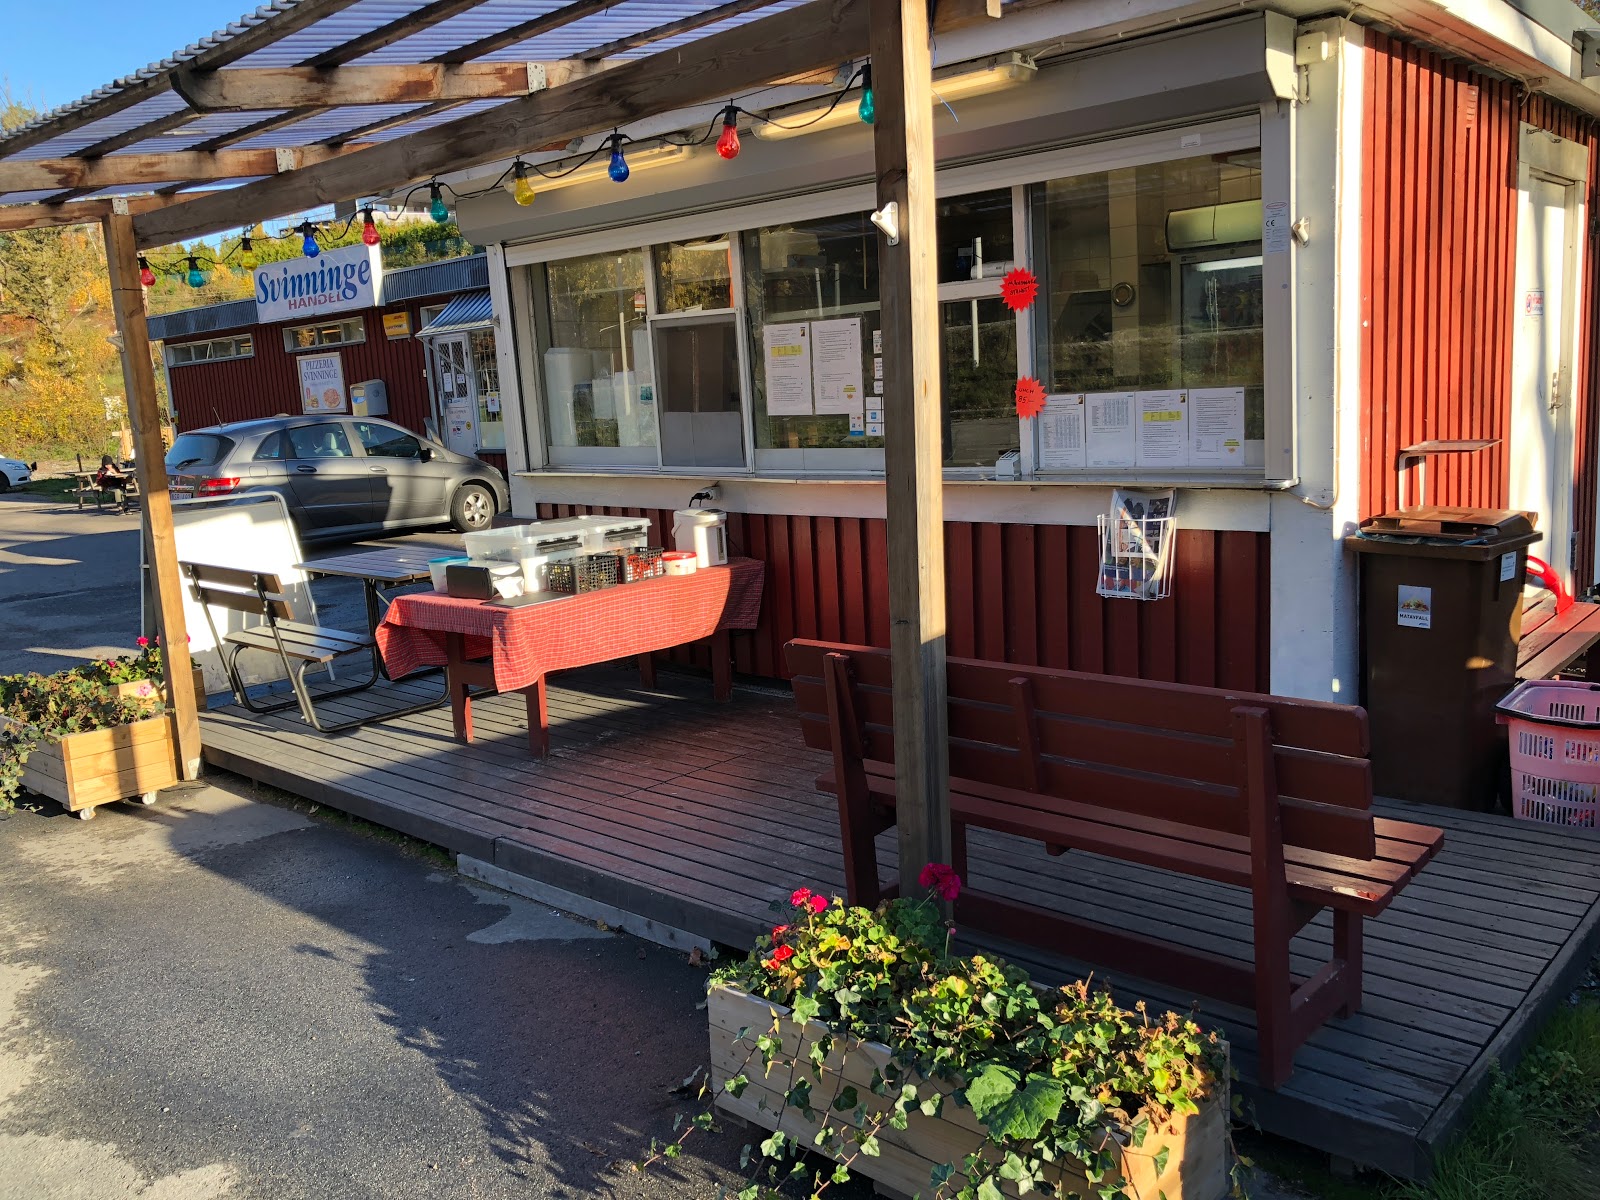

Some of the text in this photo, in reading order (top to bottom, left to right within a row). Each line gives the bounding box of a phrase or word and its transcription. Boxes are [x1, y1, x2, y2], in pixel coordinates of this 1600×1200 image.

[257, 260, 371, 304] Svinninge
[288, 291, 344, 310] HANDEL
[305, 358, 334, 370] PIZZERIA
[303, 369, 338, 381] SVINNINGE
[1399, 613, 1429, 621] MATAVFALL
